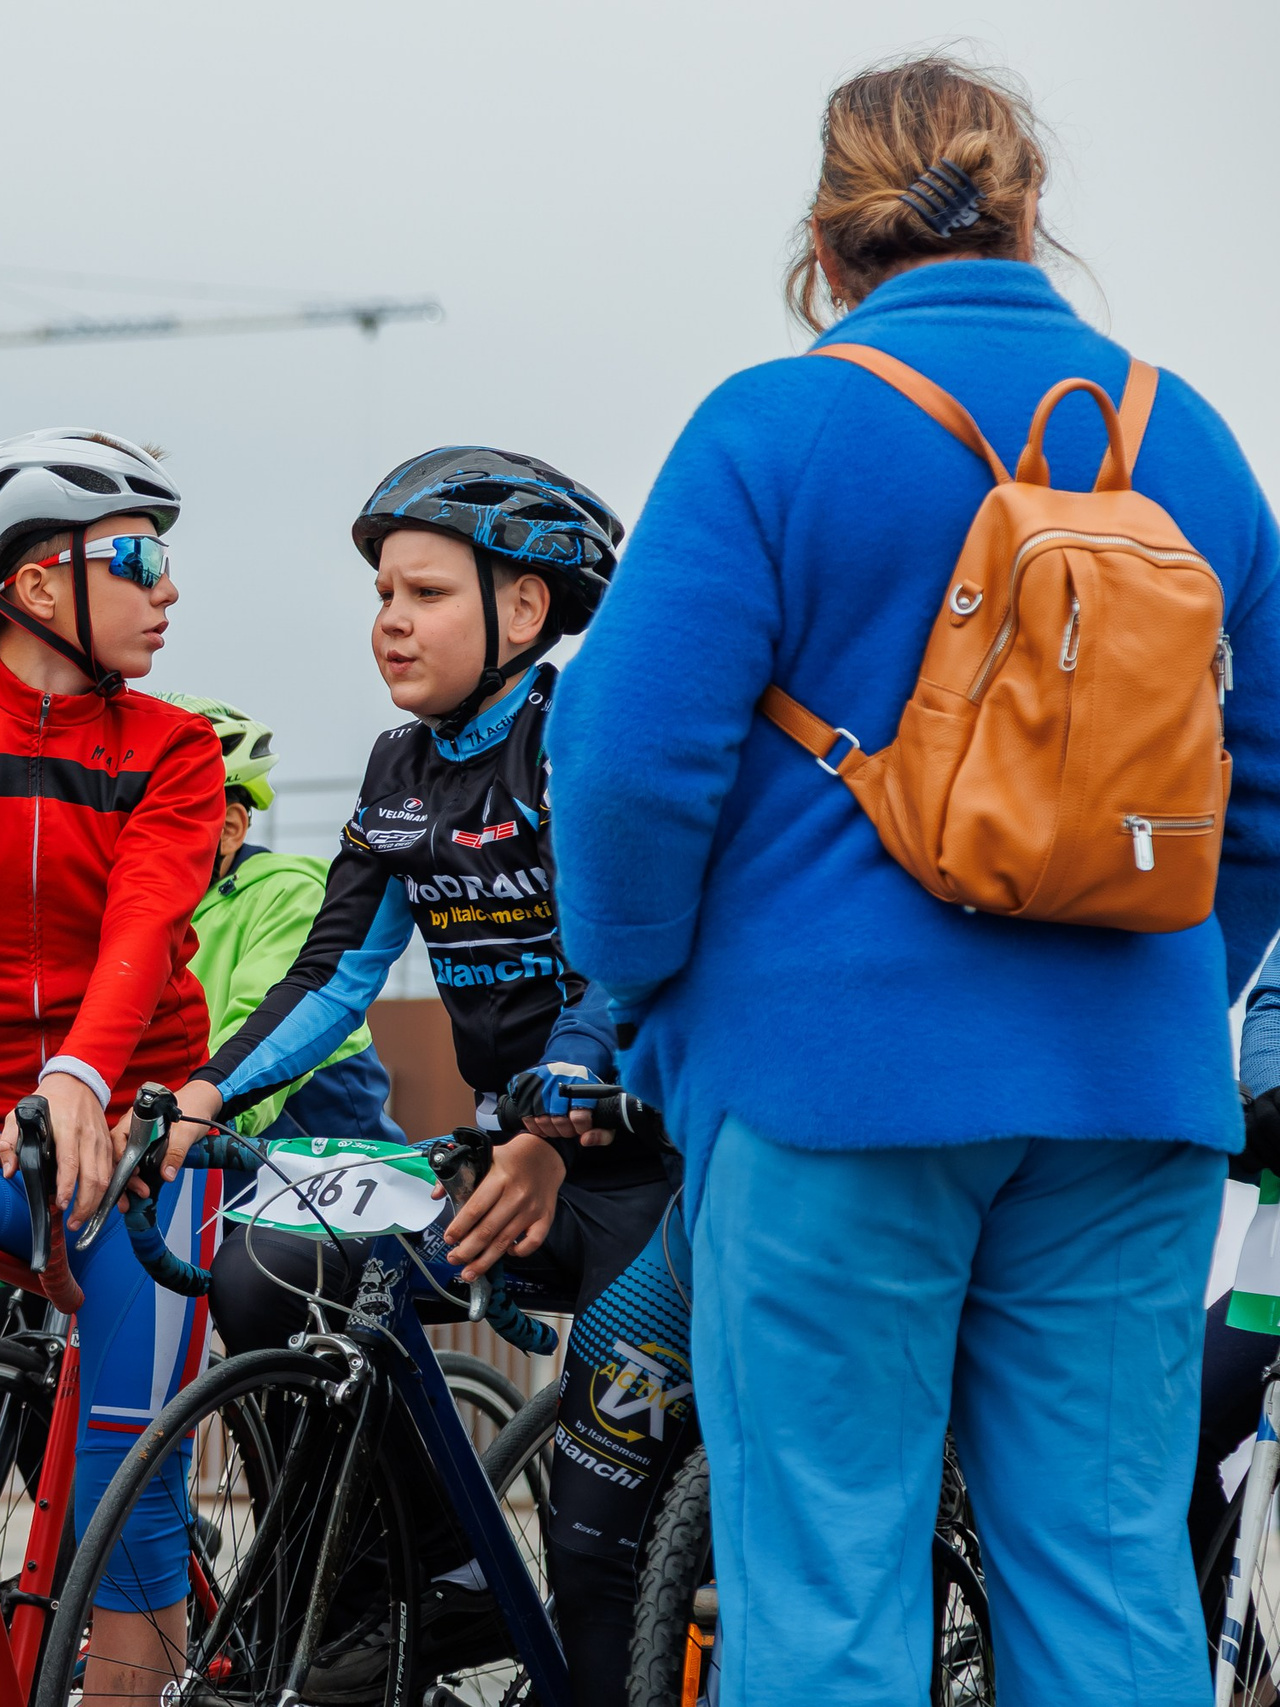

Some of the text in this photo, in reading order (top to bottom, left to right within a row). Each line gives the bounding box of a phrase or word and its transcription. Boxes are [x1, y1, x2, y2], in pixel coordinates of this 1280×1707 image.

[379, 808, 428, 822] VELDMAN
[430, 910, 449, 930] by
[297, 1169, 379, 1217] 861
[599, 1362, 687, 1420] ACTIVE
[554, 1424, 646, 1491] Bianchi
[575, 1420, 652, 1466] by Italcementi
